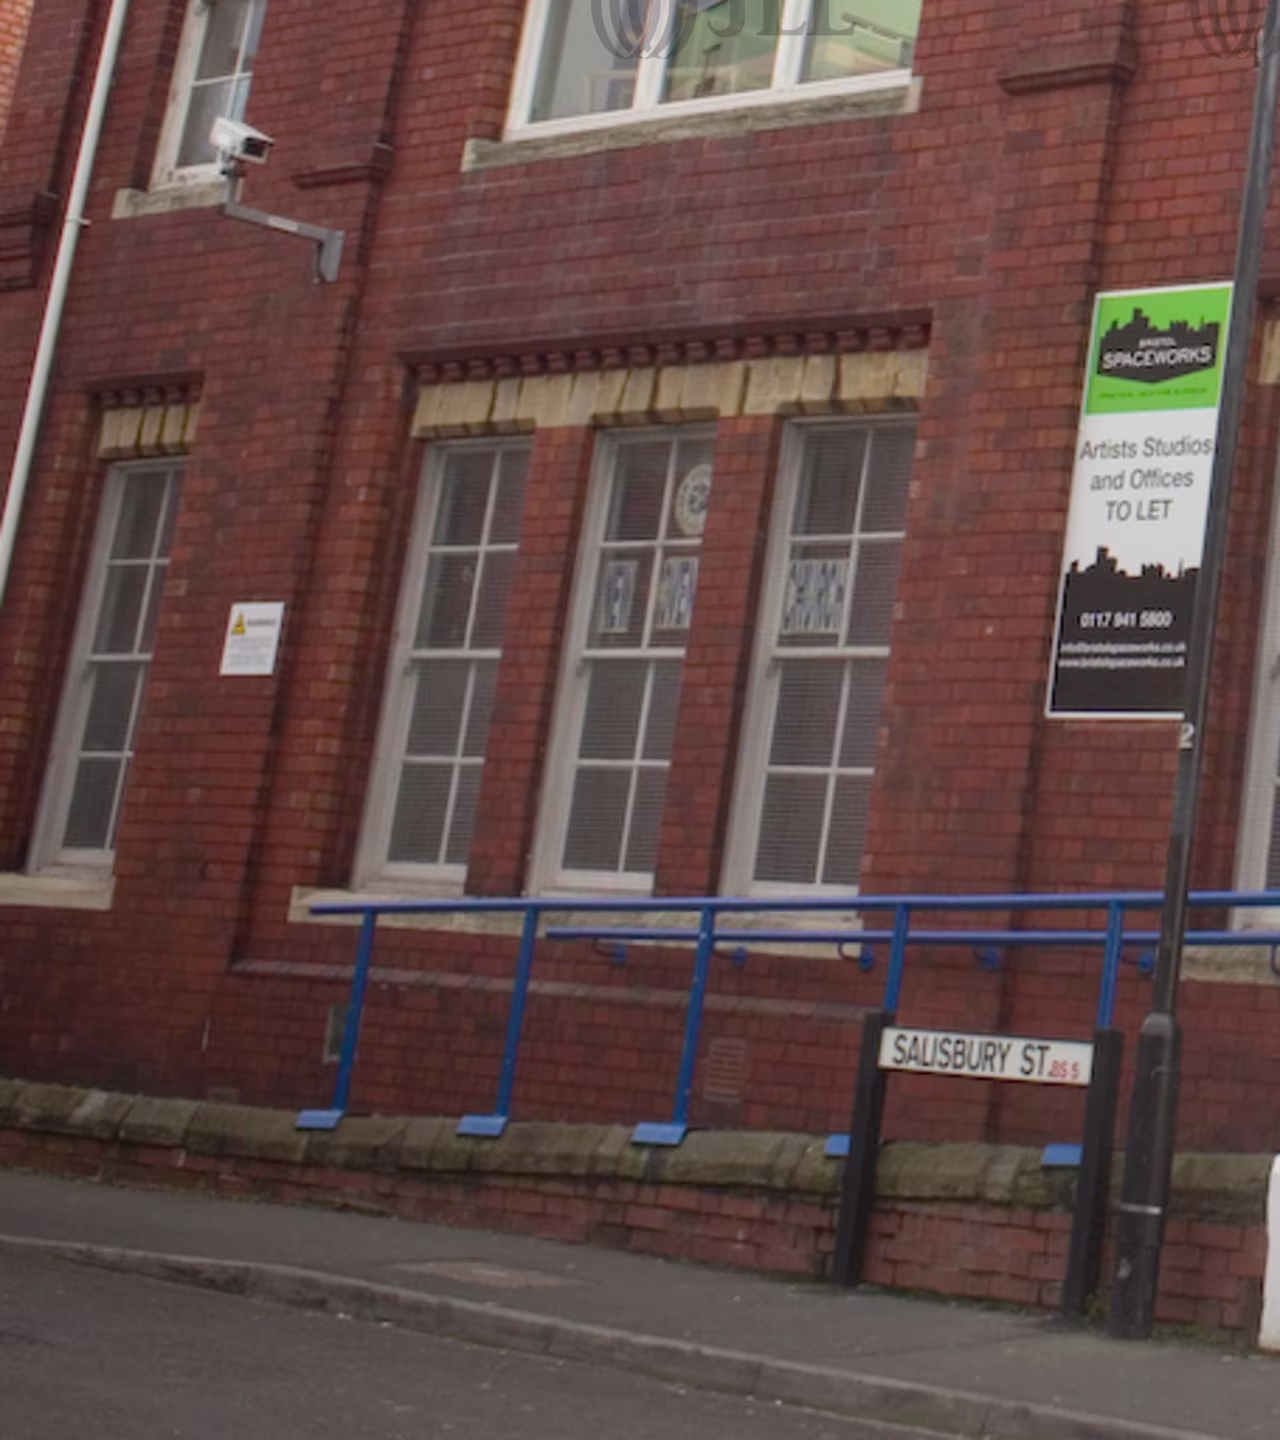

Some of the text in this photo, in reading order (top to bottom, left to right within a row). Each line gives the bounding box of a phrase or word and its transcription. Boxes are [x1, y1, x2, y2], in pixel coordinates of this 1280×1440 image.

[1102, 346, 1212, 369] SPACEWORKS
[1080, 435, 1214, 460] Artists Studios
[1090, 467, 1194, 491] and Offices
[1105, 499, 1173, 522] TO LET
[1080, 610, 1173, 628] 0117 941 5800
[892, 1034, 1012, 1072] SALISBURY
